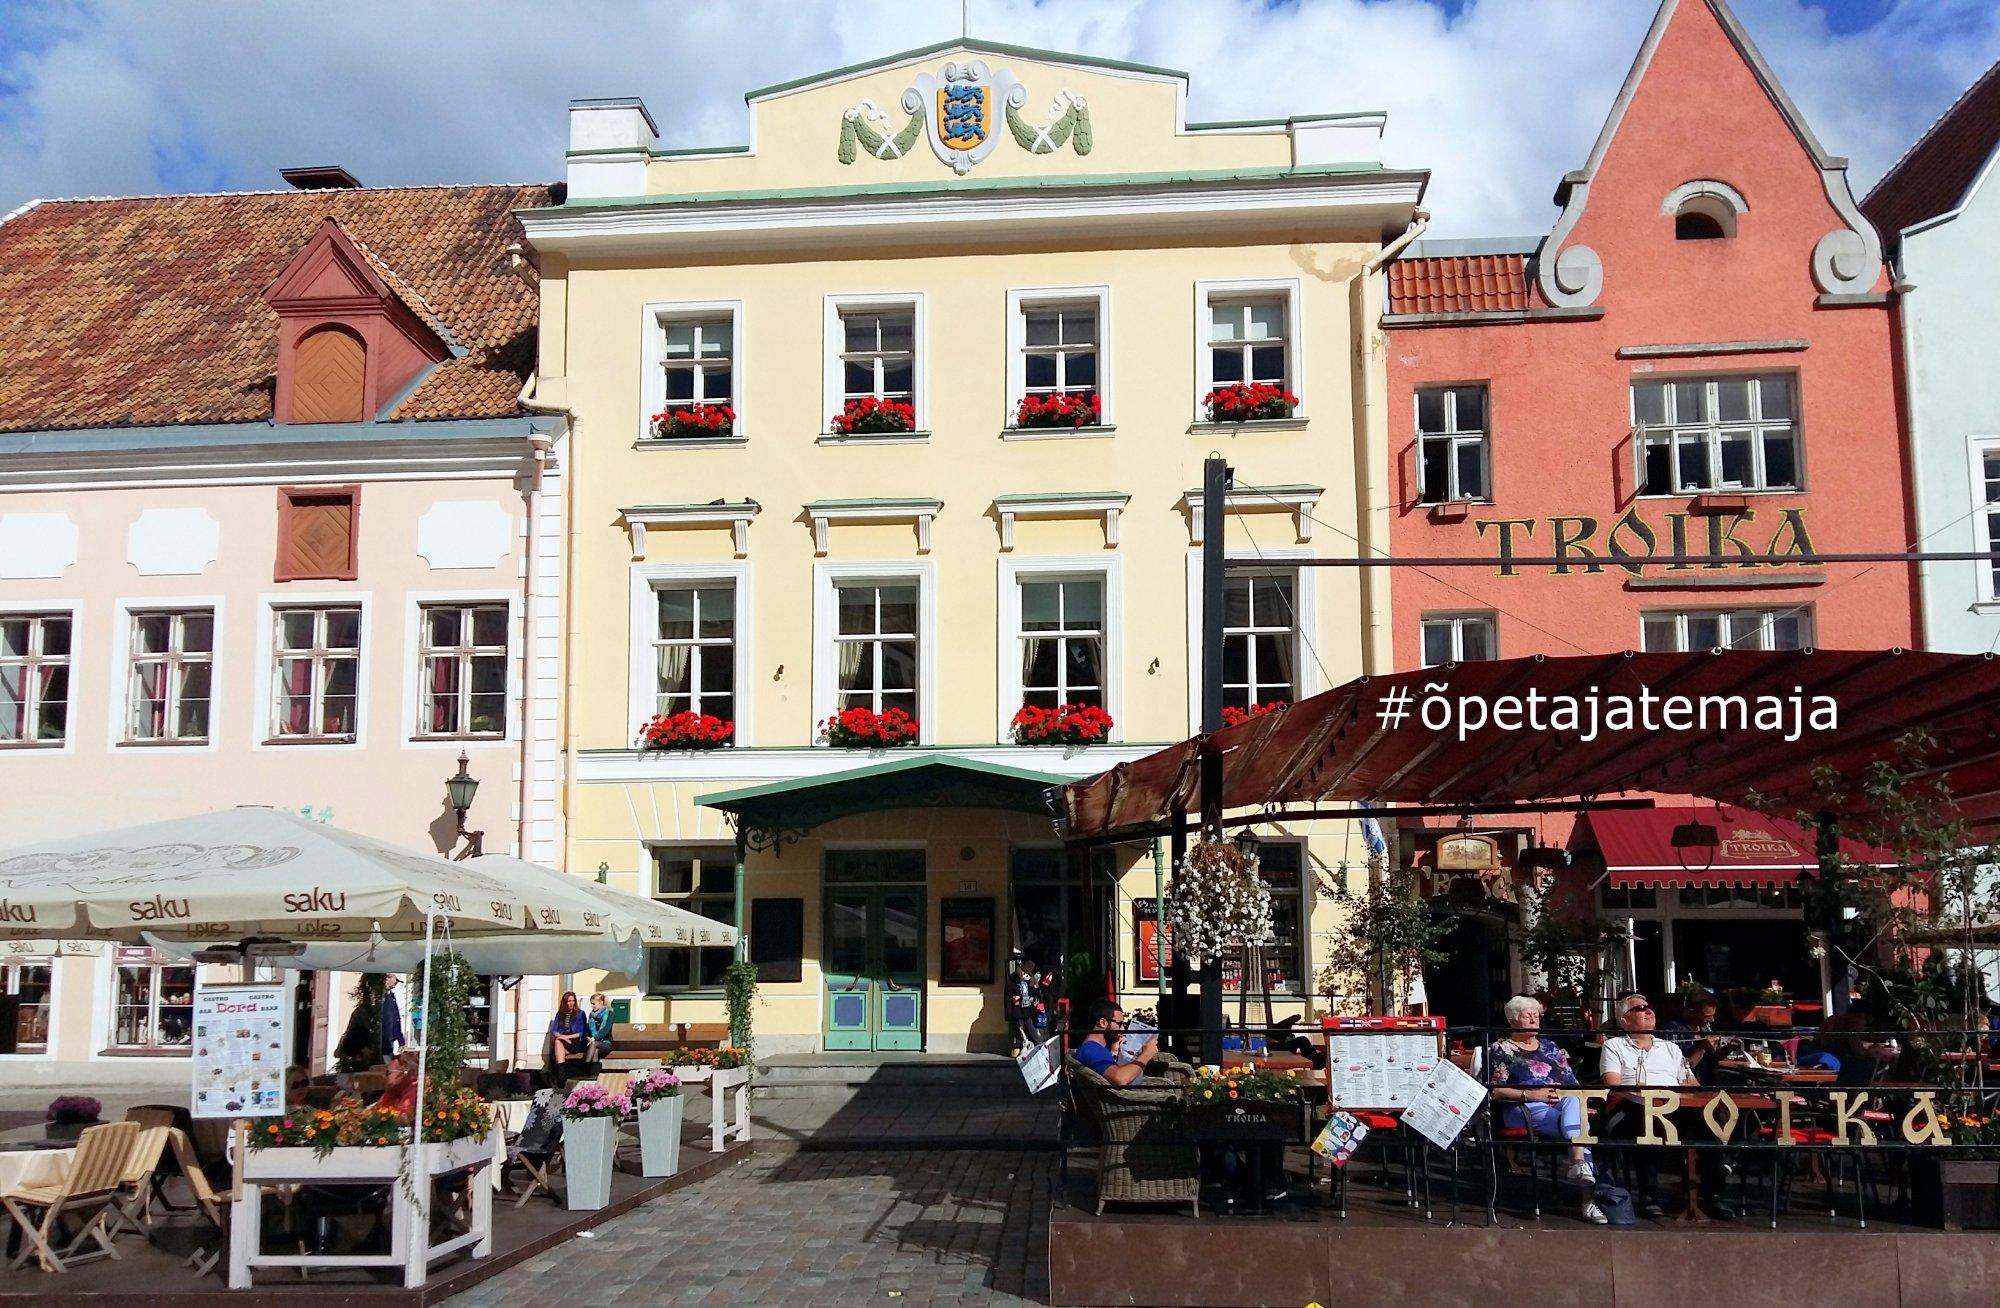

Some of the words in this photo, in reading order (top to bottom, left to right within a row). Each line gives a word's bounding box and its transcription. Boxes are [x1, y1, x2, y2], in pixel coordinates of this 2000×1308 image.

[1475, 505, 1825, 577] TROIKA
[1730, 843, 1787, 852] TROIKA
[129, 894, 191, 921] saku
[283, 887, 346, 912] saku
[490, 900, 513, 921] saku
[540, 905, 561, 925] saku
[583, 910, 601, 927] saku
[216, 1002, 258, 1013] Dora
[1226, 1114, 1267, 1123] TROIKA
[1555, 1089, 1953, 1146] TROIKA
